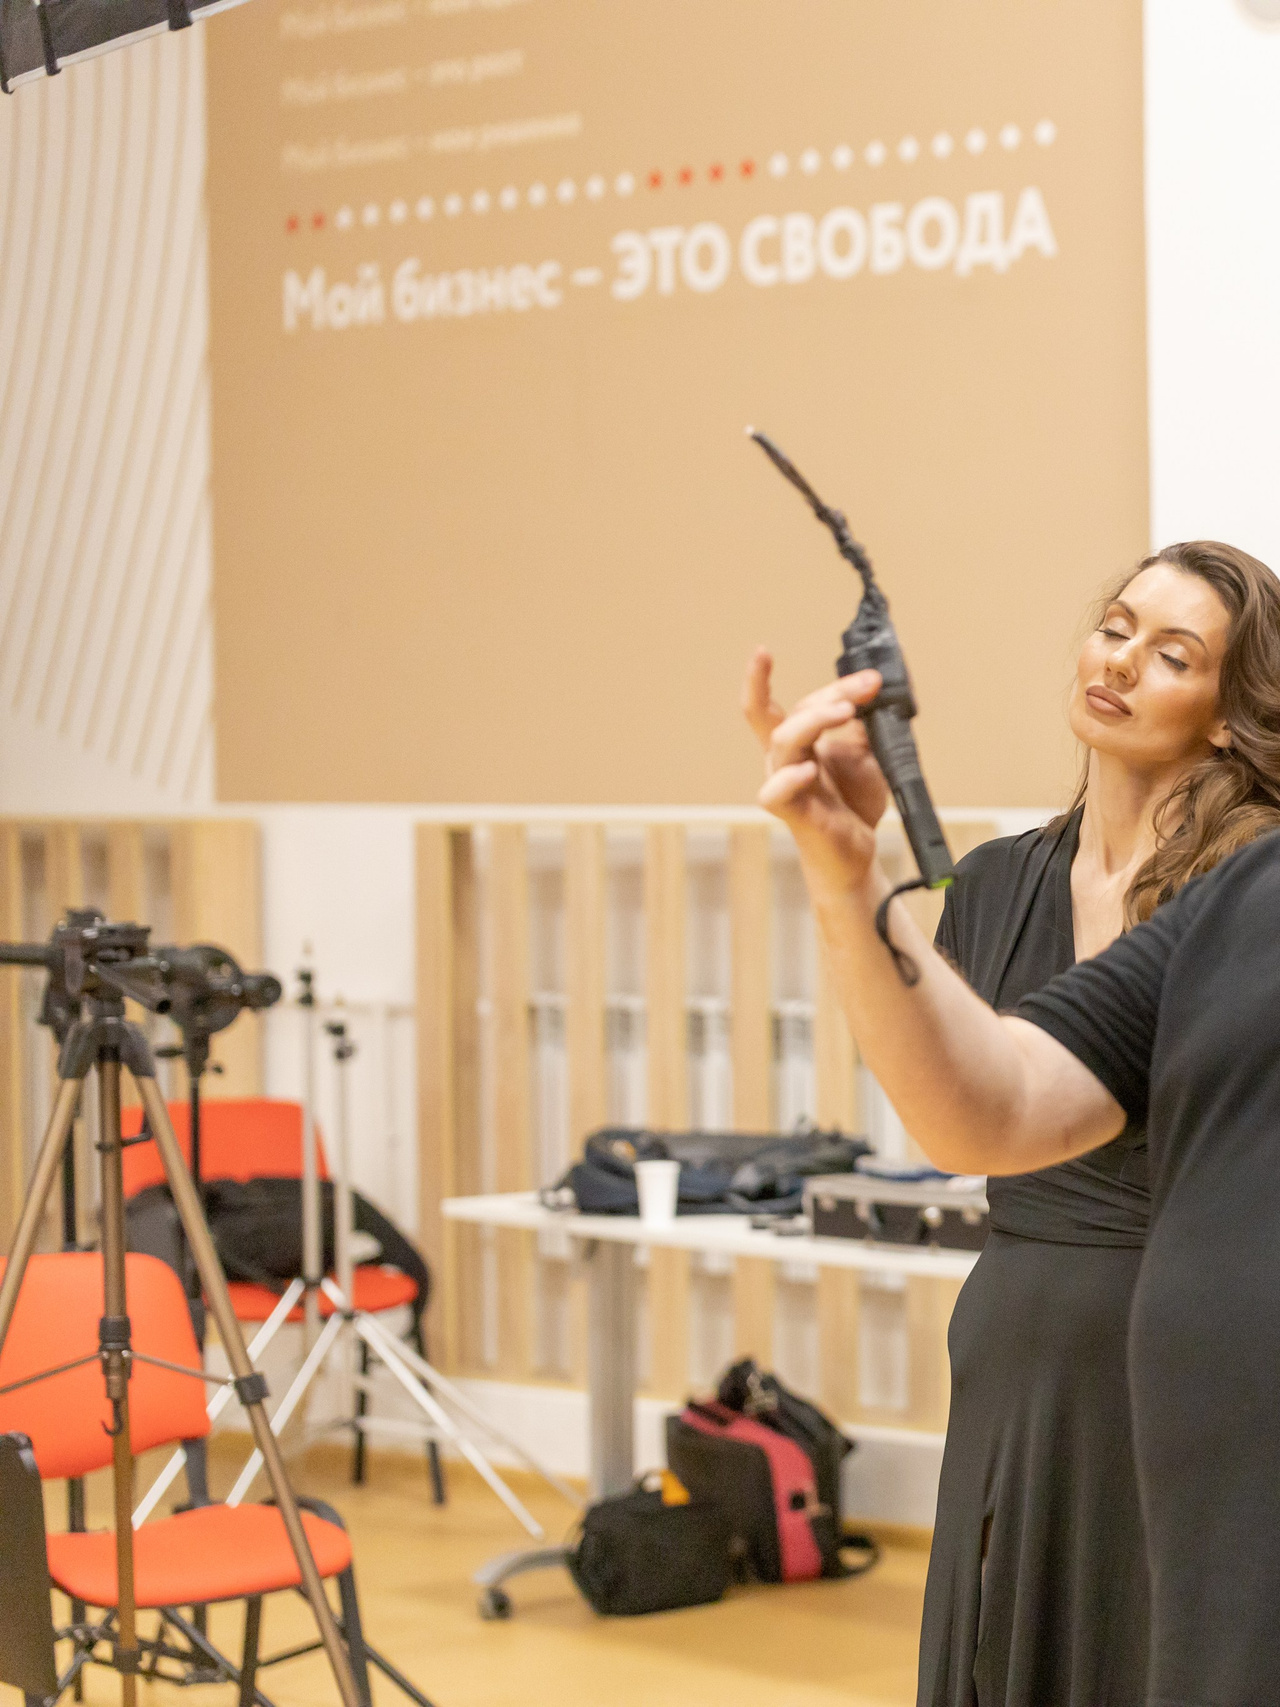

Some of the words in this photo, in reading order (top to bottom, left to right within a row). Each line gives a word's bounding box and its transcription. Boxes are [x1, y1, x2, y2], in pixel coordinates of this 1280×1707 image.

[283, 263, 385, 333] Мой
[392, 257, 562, 322] бизнес
[610, 221, 730, 300] ЭТО
[739, 185, 1058, 287] СВОБОДА
